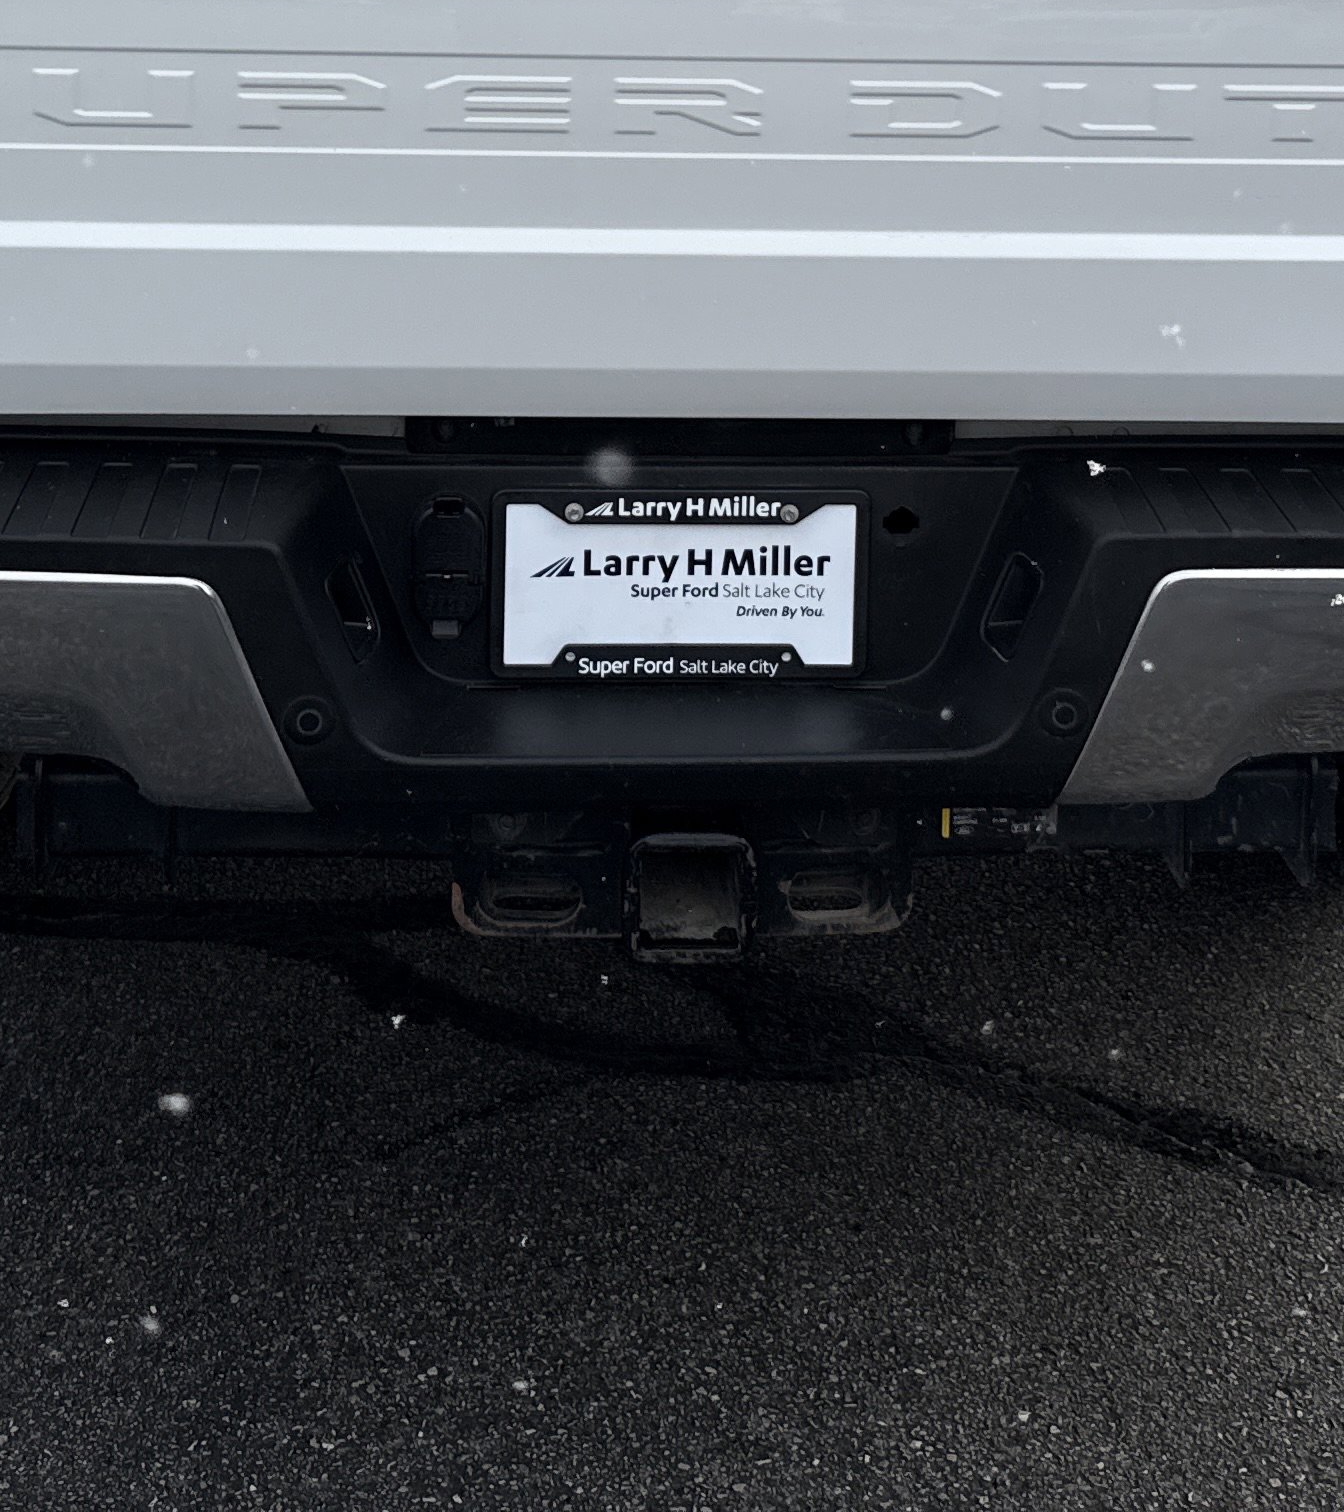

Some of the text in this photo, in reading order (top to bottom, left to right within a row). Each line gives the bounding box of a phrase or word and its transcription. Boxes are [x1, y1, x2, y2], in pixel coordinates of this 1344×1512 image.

[618, 496, 782, 521] Larry H Miller
[583, 545, 831, 583] Larry H Miller
[630, 582, 825, 602] Super Ford Salt Lake City
[736, 605, 778, 617] Driven
[781, 605, 798, 620] By
[578, 657, 779, 678] Super Ford Salt Lake City
